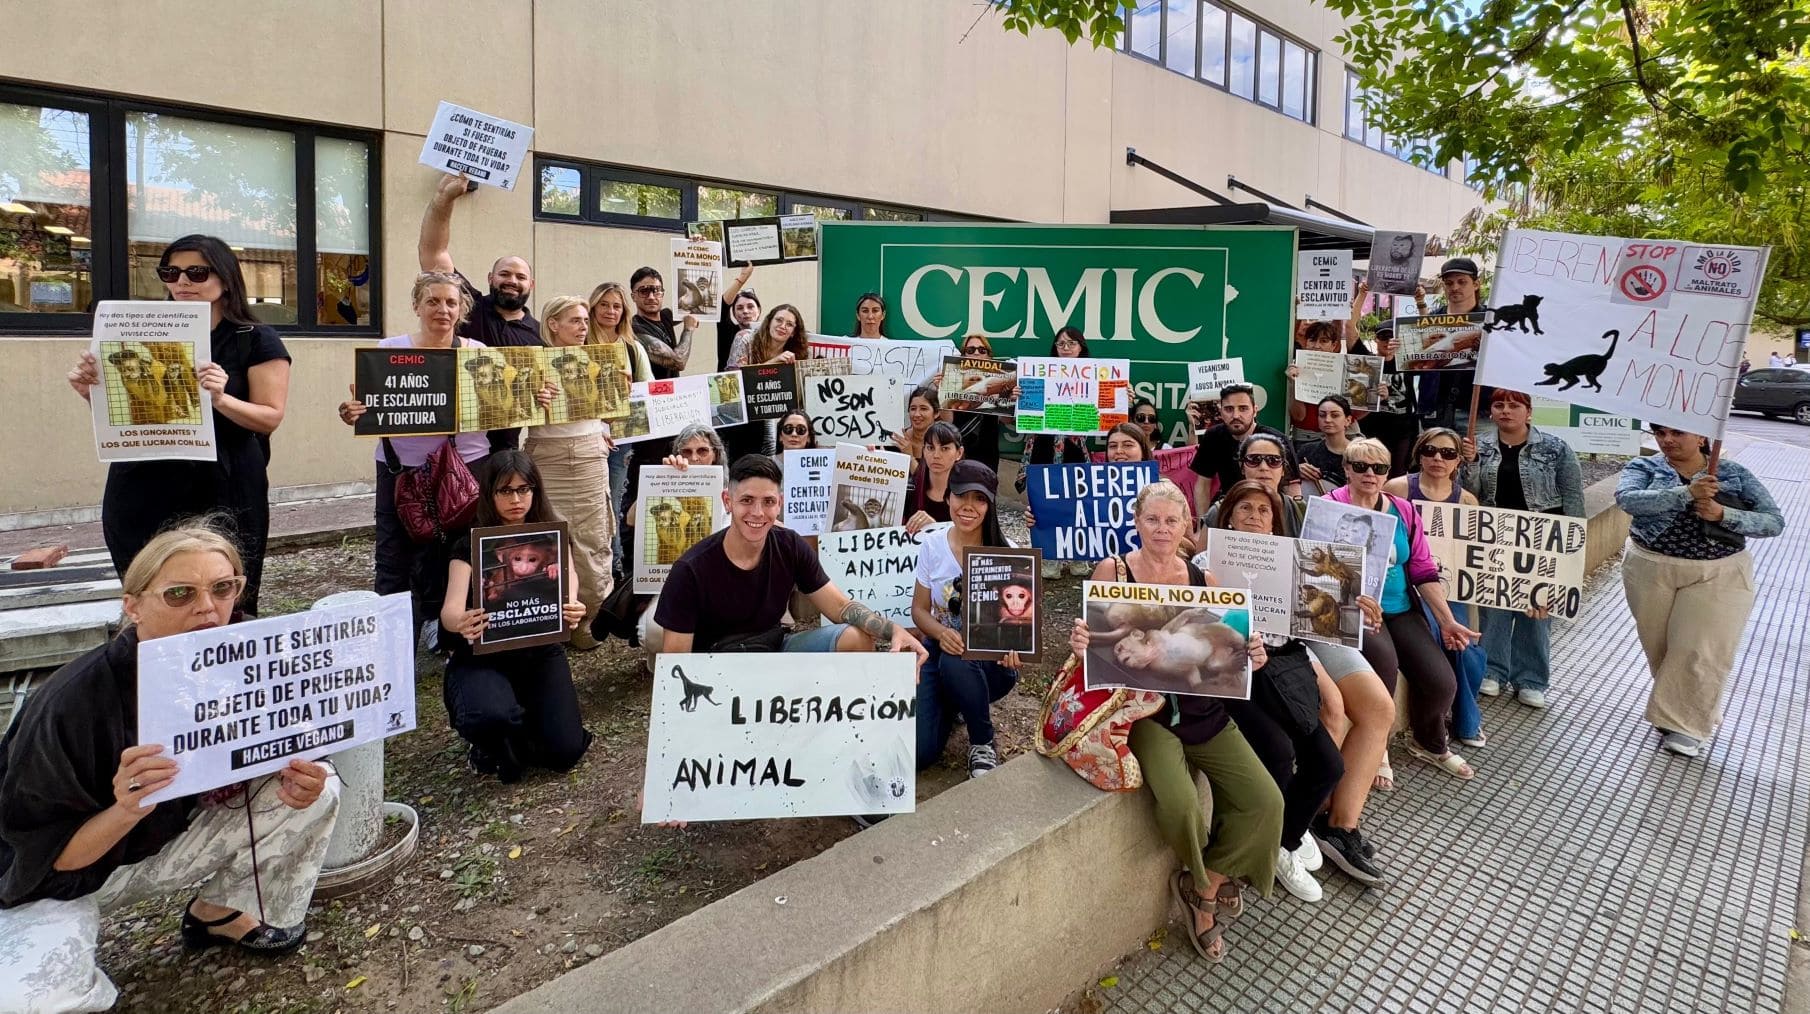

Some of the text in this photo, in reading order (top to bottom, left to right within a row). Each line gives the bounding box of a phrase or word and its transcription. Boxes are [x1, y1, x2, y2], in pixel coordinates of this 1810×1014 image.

[463, 128, 495, 144] SI FUESES
[474, 120, 483, 129] TE
[483, 122, 516, 139] SENTIRÍAS
[444, 133, 507, 160] OBJETO DE PRUEBAS
[433, 142, 510, 172] DURANTE TODA TU VIDA?
[674, 251, 720, 261] MATA MONOS
[1626, 244, 1677, 260] STOP
[1312, 256, 1338, 266] CEMIC
[1496, 236, 1622, 285] IBEREN
[1694, 250, 1714, 270] AMO
[1727, 251, 1741, 273] VIDA
[1708, 262, 1727, 275] NO
[1303, 280, 1346, 290] CENTRO DE
[1691, 279, 1737, 288] MALTRATO
[1695, 285, 1741, 295] ANIMALES
[1300, 292, 1348, 302] ESCLAVITUD
[901, 264, 1205, 344] CEMIC
[126, 312, 144, 320] tipos
[1416, 315, 1469, 327] ¡AYUDA!
[1628, 310, 1657, 348] A
[389, 354, 425, 365] CEMIC
[852, 344, 926, 379] BASTA
[961, 360, 1002, 371] ¡AYUDA!
[758, 368, 779, 376] CEMIC
[1198, 363, 1230, 373] VEGANISMO
[385, 373, 429, 389] 41 AÑOS
[756, 379, 781, 390] 41 AÑOS
[1196, 381, 1213, 390] ABUSO
[817, 378, 845, 403] NO
[365, 391, 447, 408] DE ESCLAVITUD
[747, 391, 793, 404] DE ESCLAVITUD
[835, 387, 874, 411] SON
[754, 404, 788, 415] Y TORTURA
[377, 411, 436, 426] Y TORTURA
[811, 411, 876, 438] COSAS
[1583, 416, 1628, 428] CEMIC
[140, 429, 191, 437] IGNORANTES
[121, 440, 140, 448] QUE
[142, 439, 176, 447] LUCRAN
[800, 456, 828, 468] CEMIC
[864, 456, 887, 465] CEMIC
[837, 461, 905, 479] MATA MONOS
[849, 474, 889, 485] desde 1983
[1043, 465, 1150, 499] LIBEREN
[791, 486, 824, 498] CENTRO
[788, 501, 828, 513] ESCLAVIT
[1452, 507, 1586, 555] LIBERTAD
[838, 530, 922, 553] LIBERAC
[1055, 526, 1140, 559] MONOS
[1466, 544, 1557, 579] ES UN
[971, 565, 1012, 574] EXPERIMENTOS
[984, 573, 1011, 581] ANIMALES
[847, 588, 877, 601] STA
[971, 590, 999, 602] CEMIC
[1089, 584, 1246, 605] ALGUIEN, NO ALGO
[1253, 594, 1283, 604] RANTES
[1457, 569, 1580, 619] DERECHO
[506, 597, 540, 609] NO MÁS
[487, 603, 558, 621] ESCLAVOS
[1254, 605, 1286, 615] LUCRAN
[498, 620, 510, 628] LOS
[512, 614, 558, 626] LABORATORIOS
[191, 615, 377, 672] ¿CÓMO TE SENTIRÍAS
[244, 648, 334, 685] SI FUESES
[194, 663, 376, 723] OBJETO DE PRUEBAS
[173, 682, 392, 755] DURANTE TODA TU VIDA?
[243, 724, 345, 765] HACETE VEGANO
